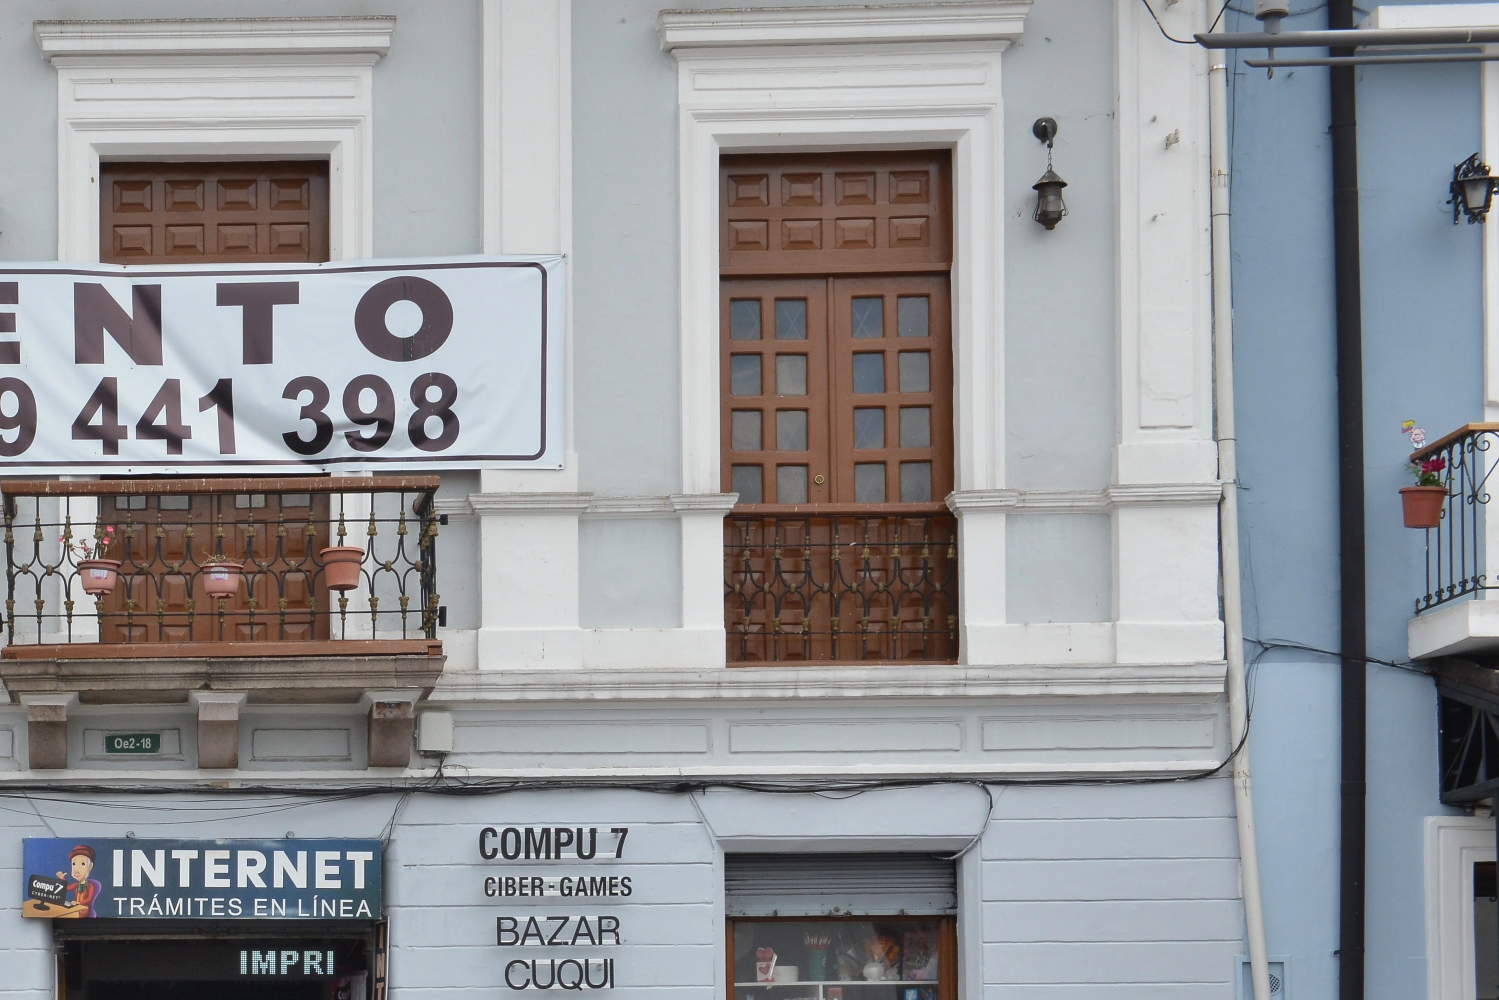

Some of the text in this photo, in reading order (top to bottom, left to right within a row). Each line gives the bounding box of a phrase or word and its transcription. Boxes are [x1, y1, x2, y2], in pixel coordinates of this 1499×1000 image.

[71, 376, 237, 456] 441
[281, 372, 461, 456] 398
[114, 737, 152, 749] Oe2-18
[479, 827, 629, 860] COMPU 7
[112, 849, 374, 889] INTERNET
[32, 880, 64, 895] Compu 7
[484, 876, 544, 897] CIBER
[559, 876, 633, 897] GAMES
[113, 893, 373, 918] TRÁMITES EN LÍNEA
[496, 916, 621, 946] BAZAR
[240, 950, 334, 975] IMPRI
[504, 958, 615, 991] CUQUI
